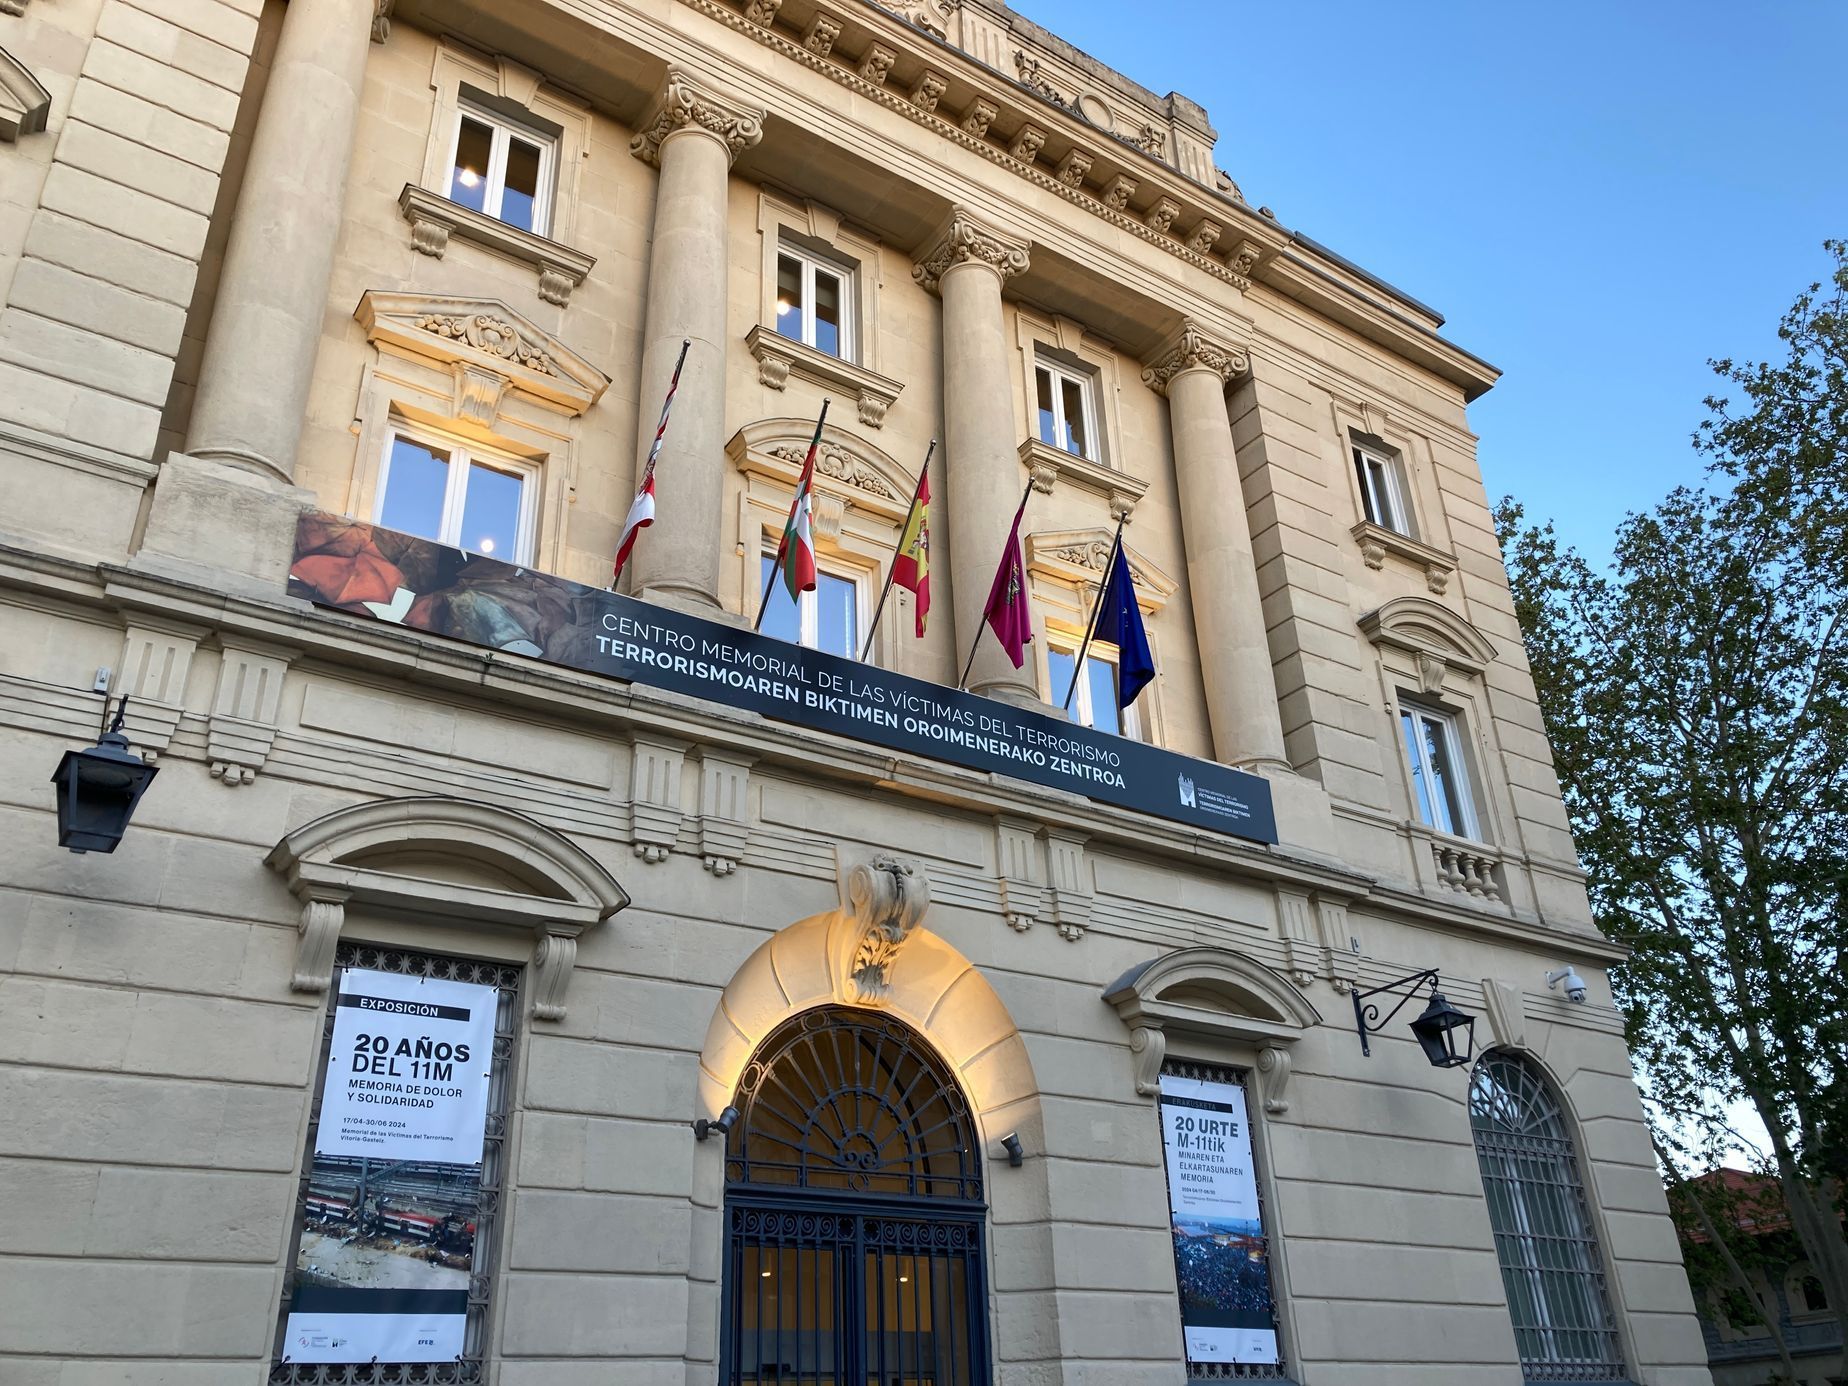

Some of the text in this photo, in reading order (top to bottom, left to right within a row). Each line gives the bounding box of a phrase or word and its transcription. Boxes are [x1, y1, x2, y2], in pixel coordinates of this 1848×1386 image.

[602, 613, 1121, 768] CENTRO MEMORIAL DE LAS VÍCTIMAS DEL TERRORISMO
[595, 634, 1127, 790] TERRORISMOAREN BIKTIMEN OROIMENERAKO ZENTROA
[360, 998, 439, 1017] EXPOSICIÓN
[354, 1033, 470, 1062] 20 AÑOS
[351, 1053, 453, 1082] DEL 11M
[348, 1079, 463, 1098] MEMORIA DE DOLOR
[347, 1092, 434, 1109] Y SOLIDARIDAD
[1172, 1097, 1217, 1111] ERAKUSKETA
[343, 1117, 387, 1127] 17/04-30/06
[1175, 1116, 1239, 1138] 20 URTE
[1177, 1132, 1226, 1153] M-11tik
[1178, 1151, 1224, 1163] MINAREN ETA
[1179, 1162, 1243, 1176] ELKARTASUNAREN
[1180, 1173, 1214, 1184] MEMORIA
